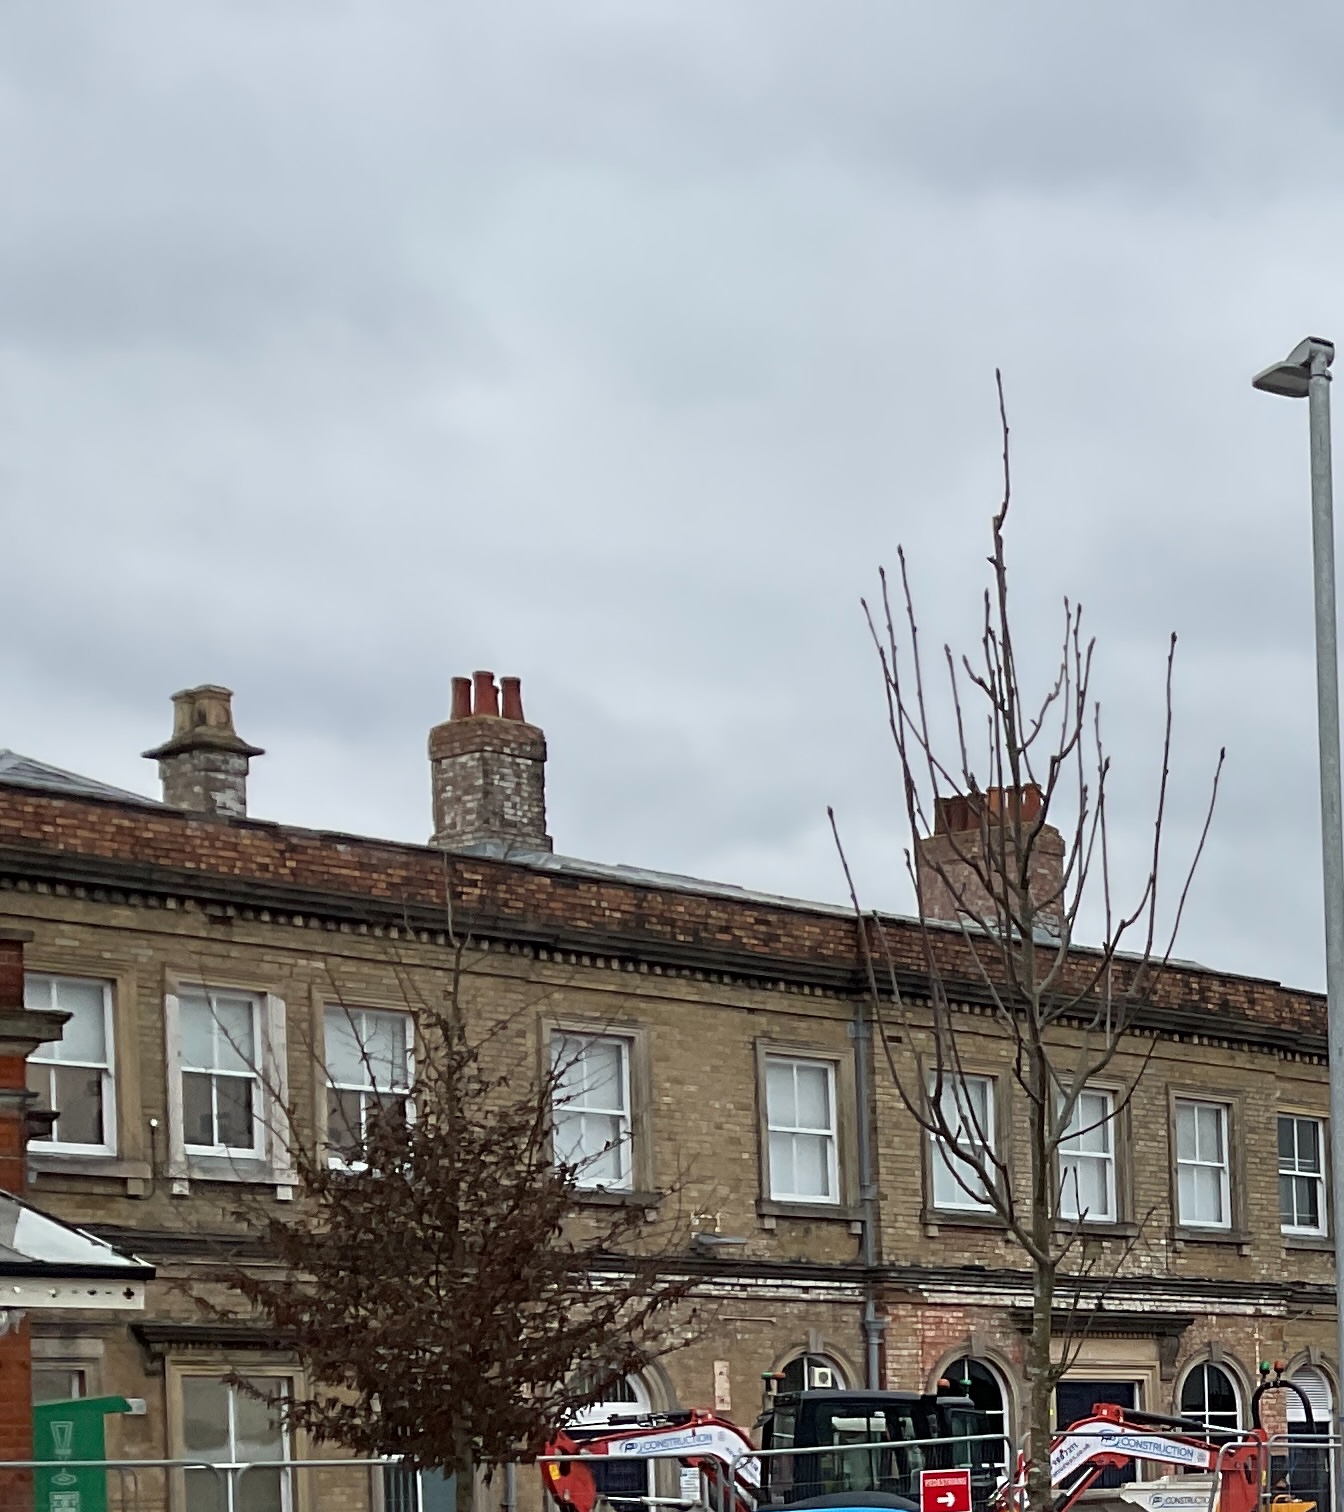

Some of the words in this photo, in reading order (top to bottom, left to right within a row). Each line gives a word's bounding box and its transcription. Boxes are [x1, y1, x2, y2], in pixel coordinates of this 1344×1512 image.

[644, 1433, 712, 1450] CONSTRUCTION
[1120, 1437, 1194, 1458] CONSTRUCTION
[1165, 1496, 1210, 1504] CONSTRUCTIO
